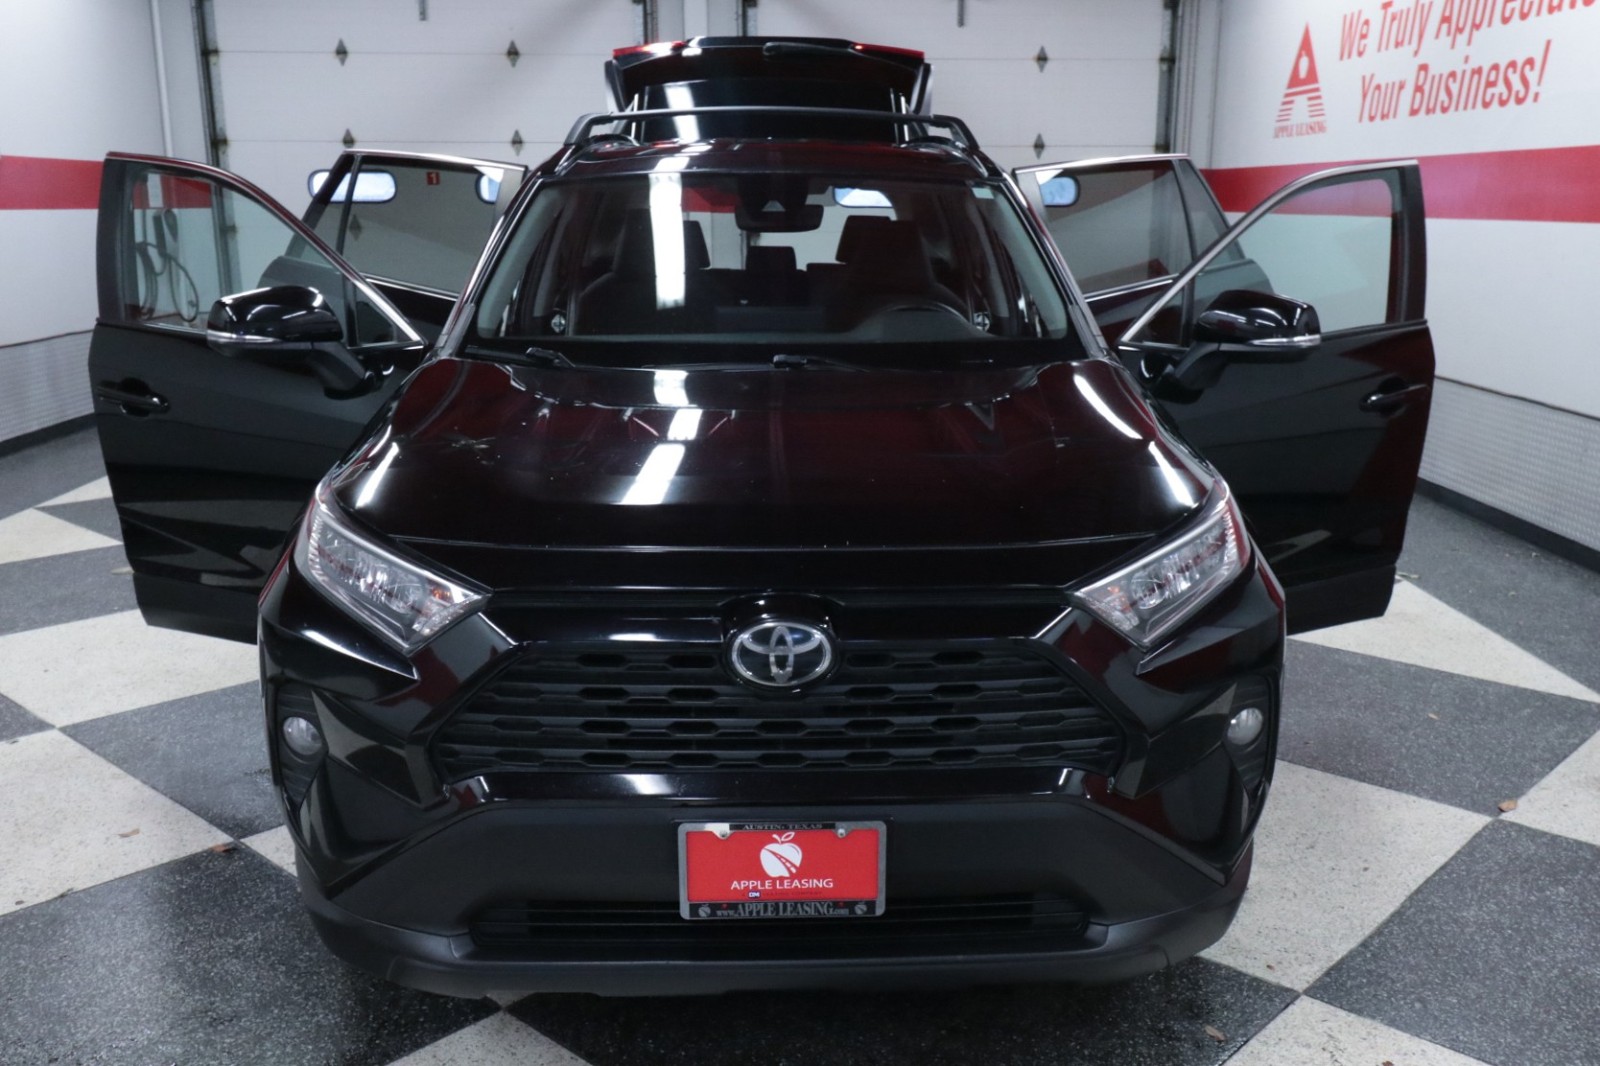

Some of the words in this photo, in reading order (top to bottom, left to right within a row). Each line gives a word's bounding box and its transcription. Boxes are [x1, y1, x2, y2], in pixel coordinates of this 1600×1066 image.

[1339, 9, 1370, 61] We
[1377, 0, 1433, 57] Truly
[1434, 0, 1597, 49] Apprec
[1358, 73, 1406, 123] Your
[1408, 39, 1552, 117] Business!
[730, 880, 773, 890] APPLE
[776, 878, 834, 889] LEASING
